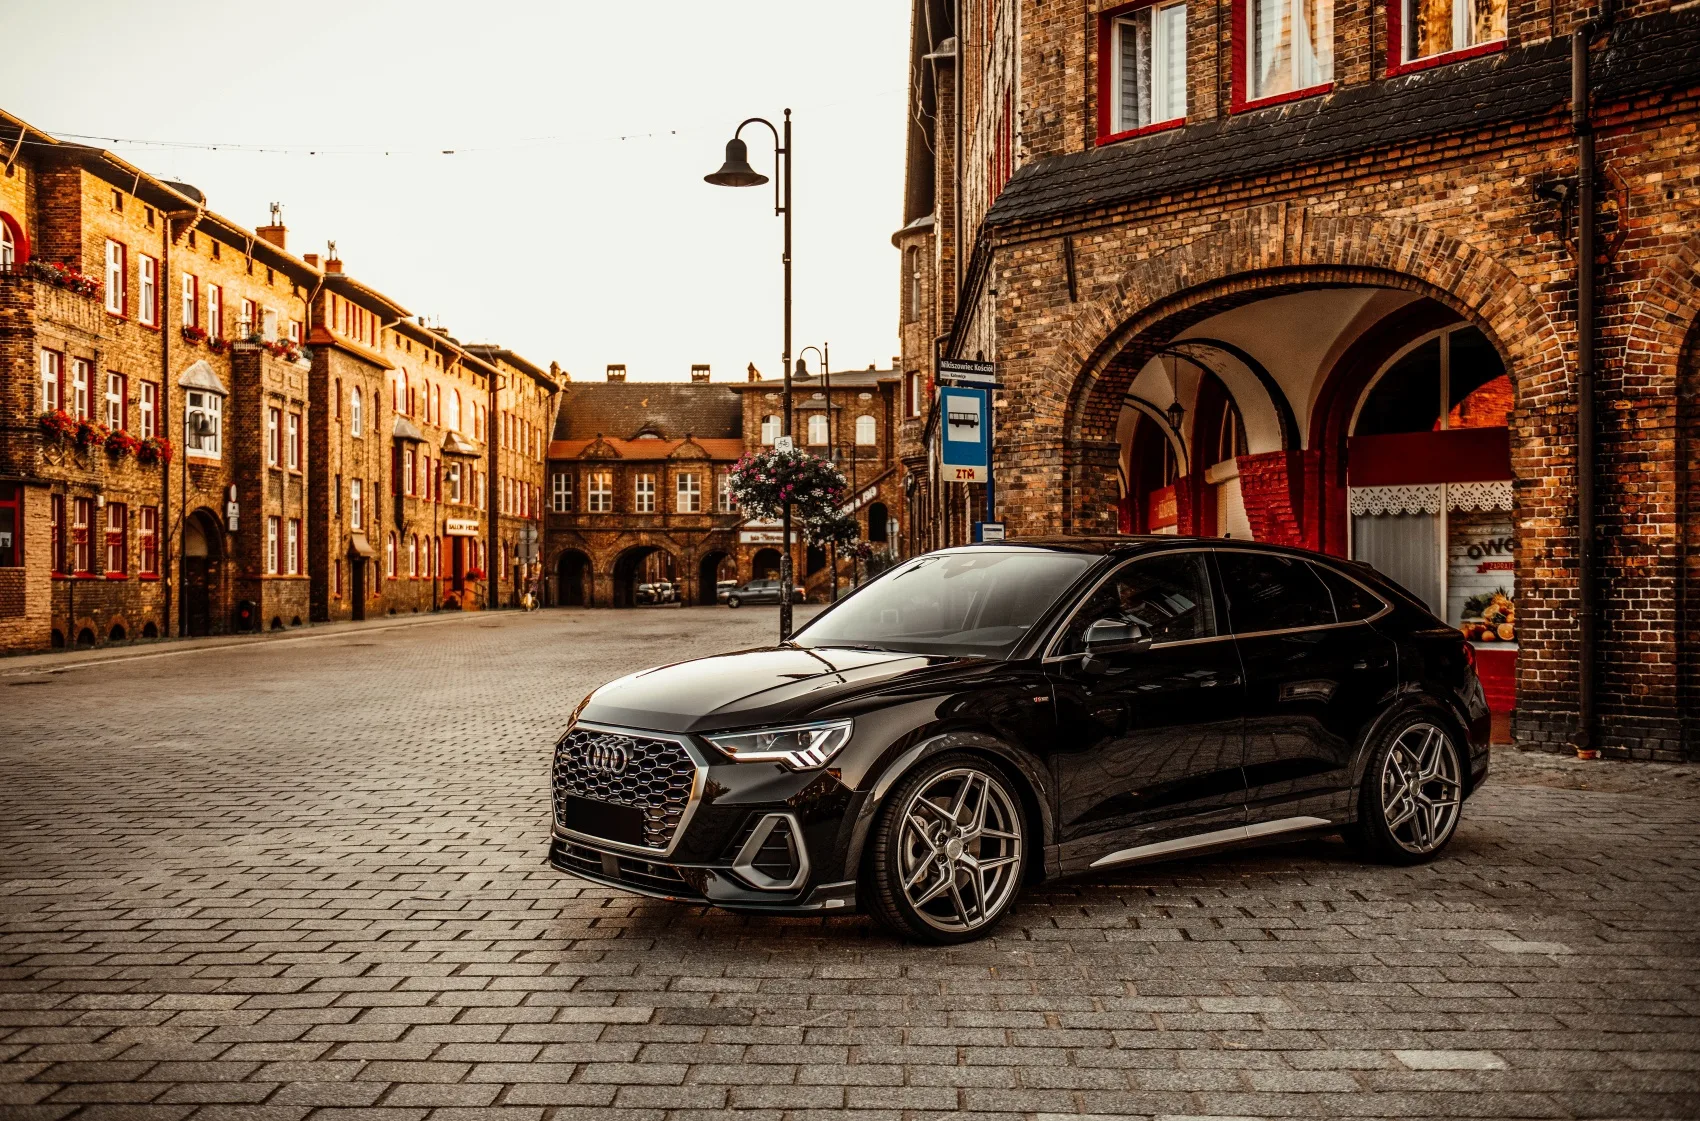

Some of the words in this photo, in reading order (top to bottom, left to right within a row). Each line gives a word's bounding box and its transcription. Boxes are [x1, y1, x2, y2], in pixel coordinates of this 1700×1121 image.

[941, 361, 973, 371] Nikiszowiec
[974, 364, 993, 373] Kościół
[956, 469, 975, 479] ZTM
